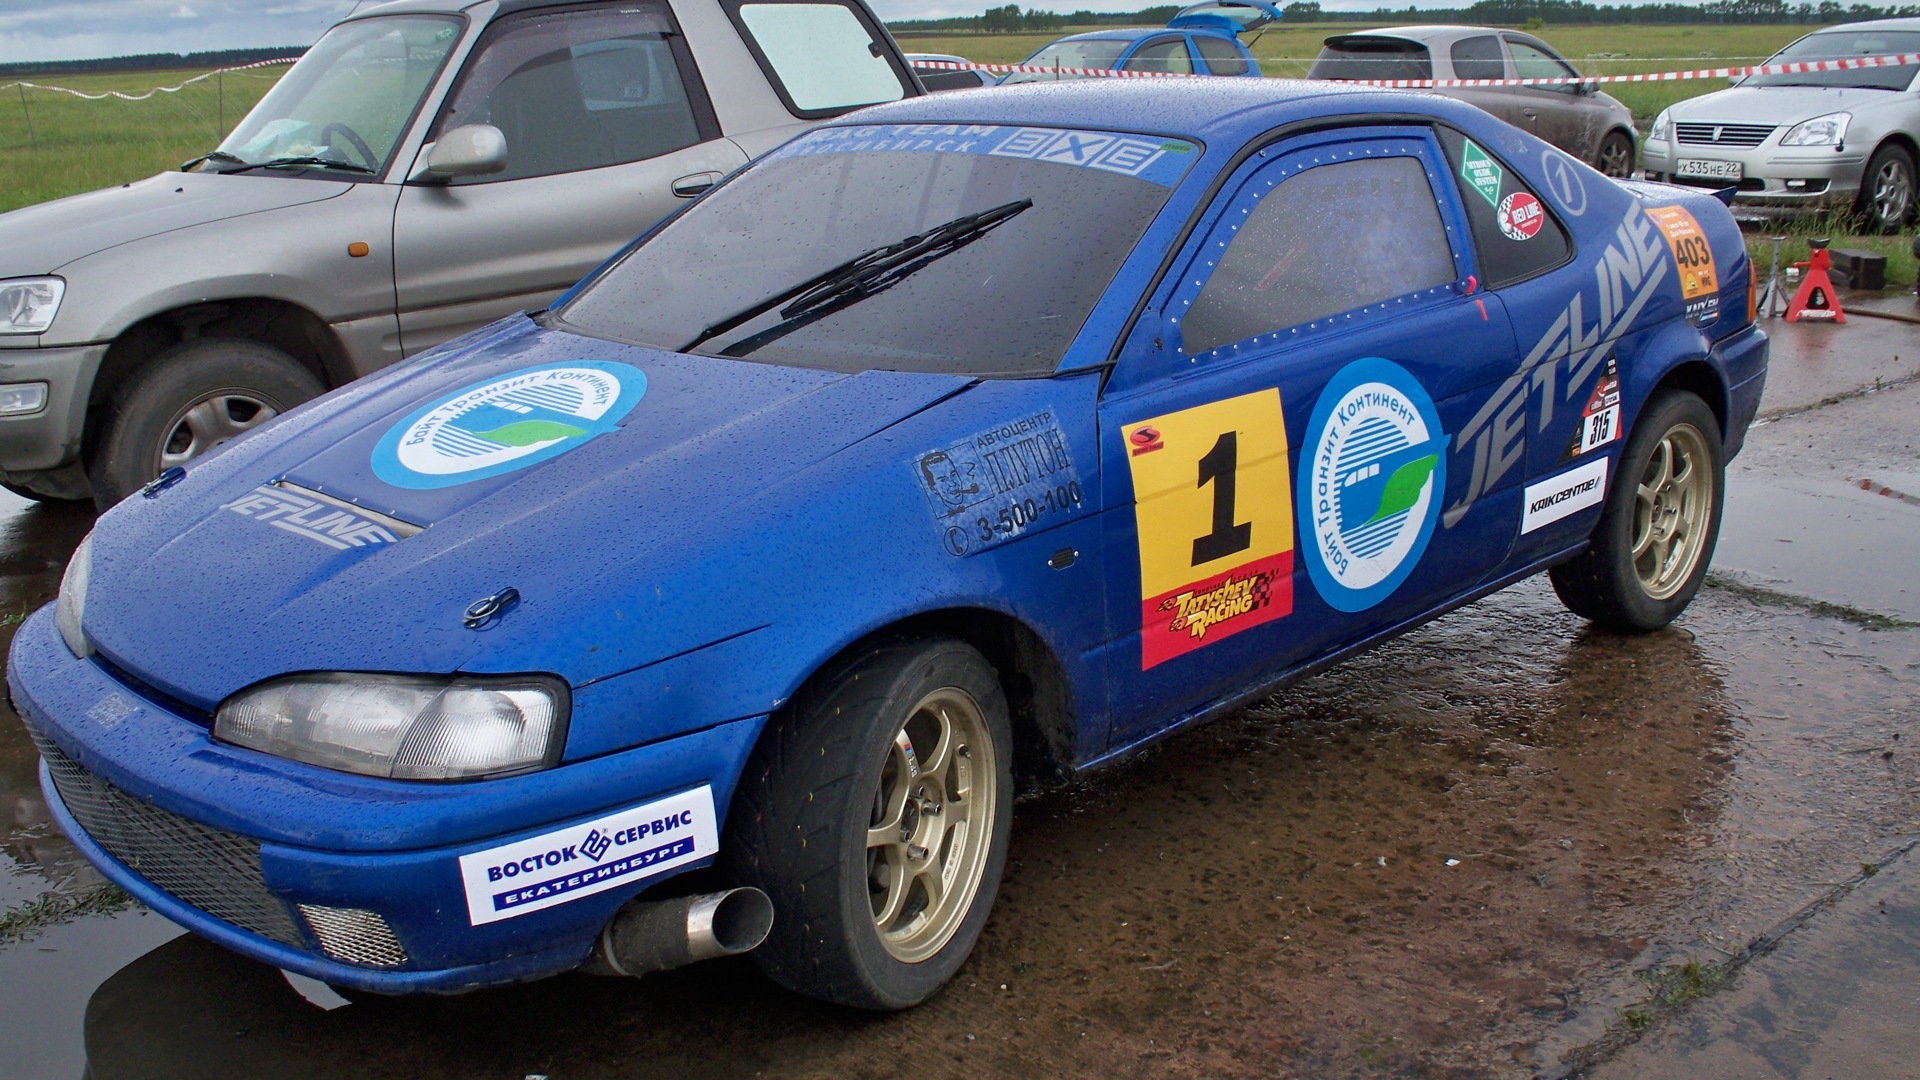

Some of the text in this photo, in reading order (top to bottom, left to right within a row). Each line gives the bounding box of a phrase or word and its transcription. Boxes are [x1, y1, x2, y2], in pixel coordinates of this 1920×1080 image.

[784, 139, 977, 157] ОВОСИБИРСК
[891, 124, 1000, 137] TEAM
[1512, 206, 1527, 224] RED
[1525, 201, 1541, 219] LINE
[1676, 236, 1710, 268] 403
[1443, 202, 1663, 529] JETLINE
[440, 375, 540, 413] Транзит
[546, 371, 614, 405] Континент
[977, 411, 1051, 449] АВТОЦЕНТР
[1590, 410, 1611, 445] 315
[983, 428, 1071, 495] ПЛУТОН
[1318, 427, 1340, 528] Транзит
[1338, 392, 1415, 427] Континент
[977, 480, 1082, 542] 3-500-100
[1191, 430, 1252, 567] 1
[487, 810, 692, 882] ВОСТОК СЕРВИС
[505, 843, 685, 904] ЕКАТЕРИНБУРГ
